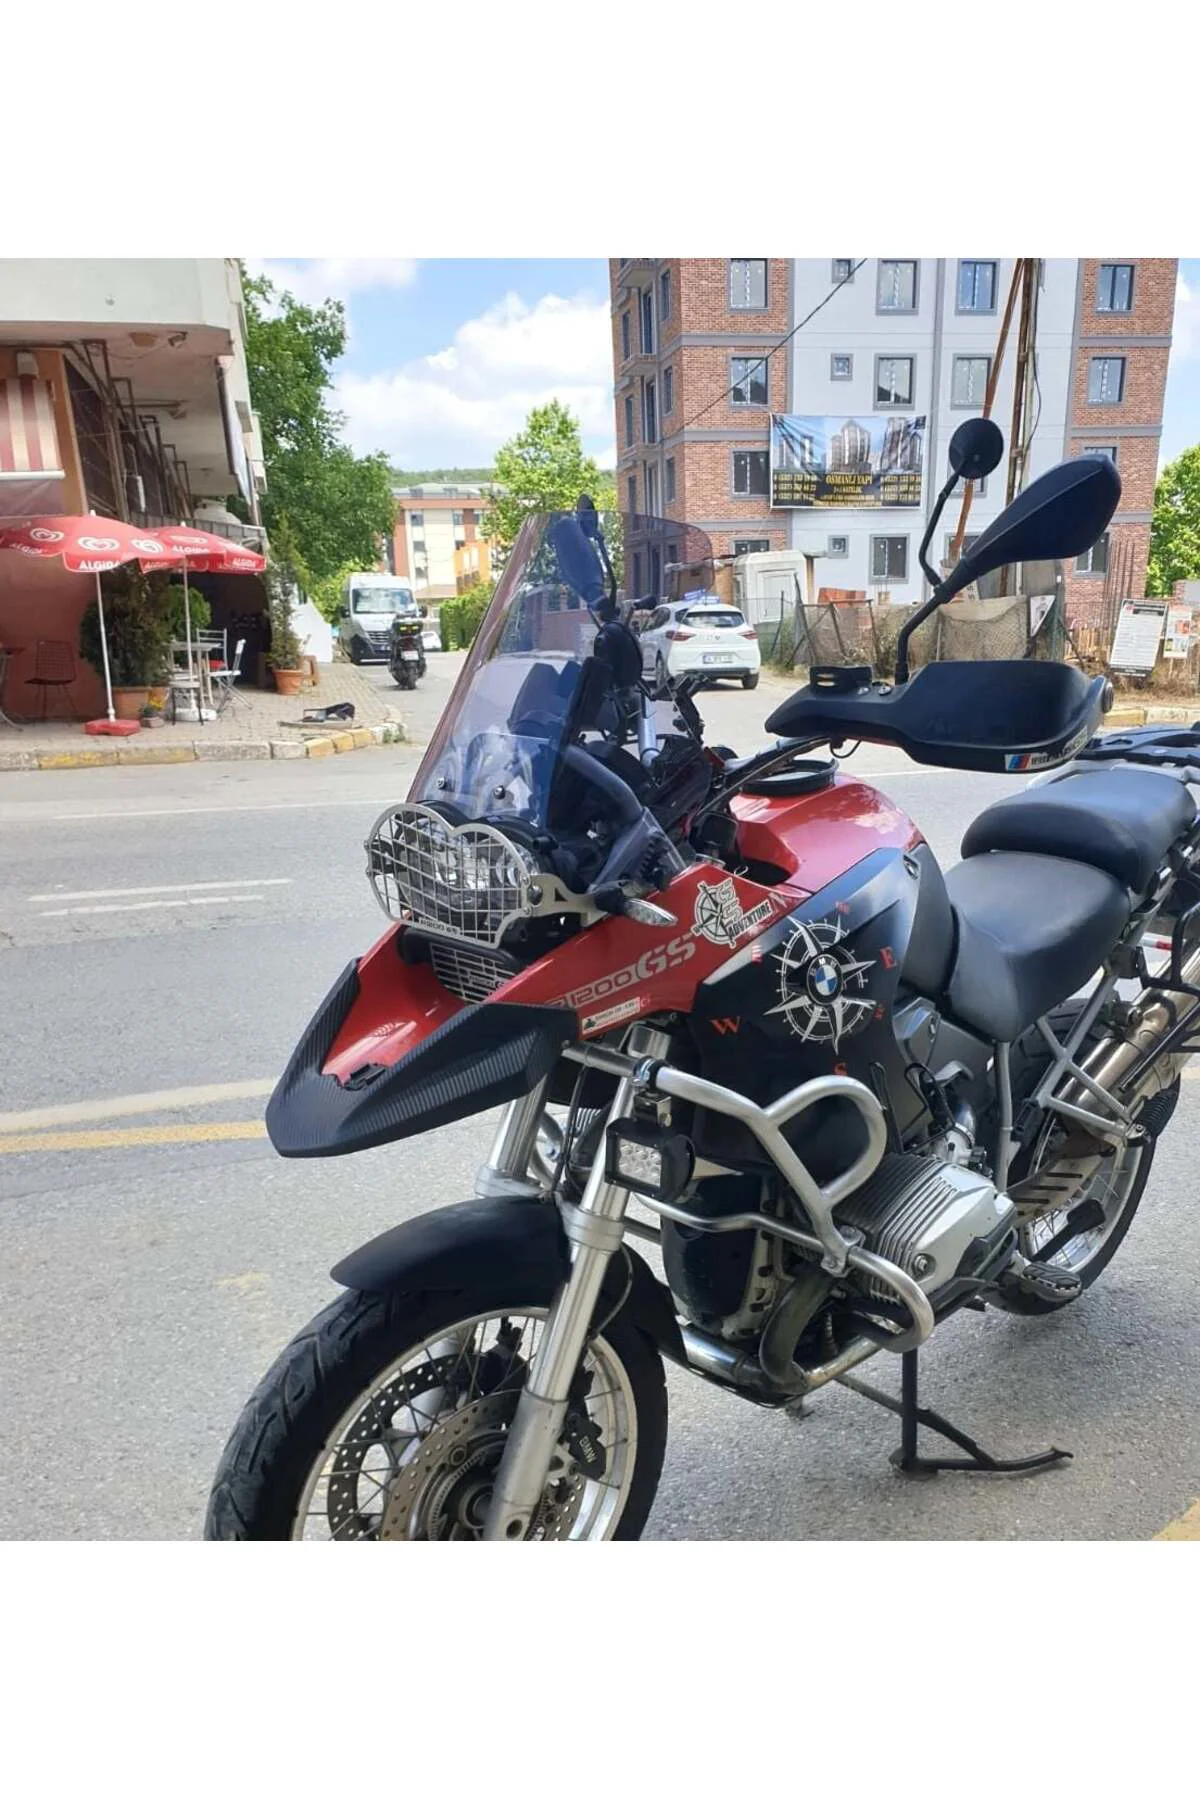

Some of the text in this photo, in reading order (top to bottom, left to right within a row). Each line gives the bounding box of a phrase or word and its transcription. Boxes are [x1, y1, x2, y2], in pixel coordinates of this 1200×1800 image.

[727, 901, 772, 938] ADVENTURE
[710, 1017, 741, 1035] W
[579, 1435, 597, 1463] BMW
